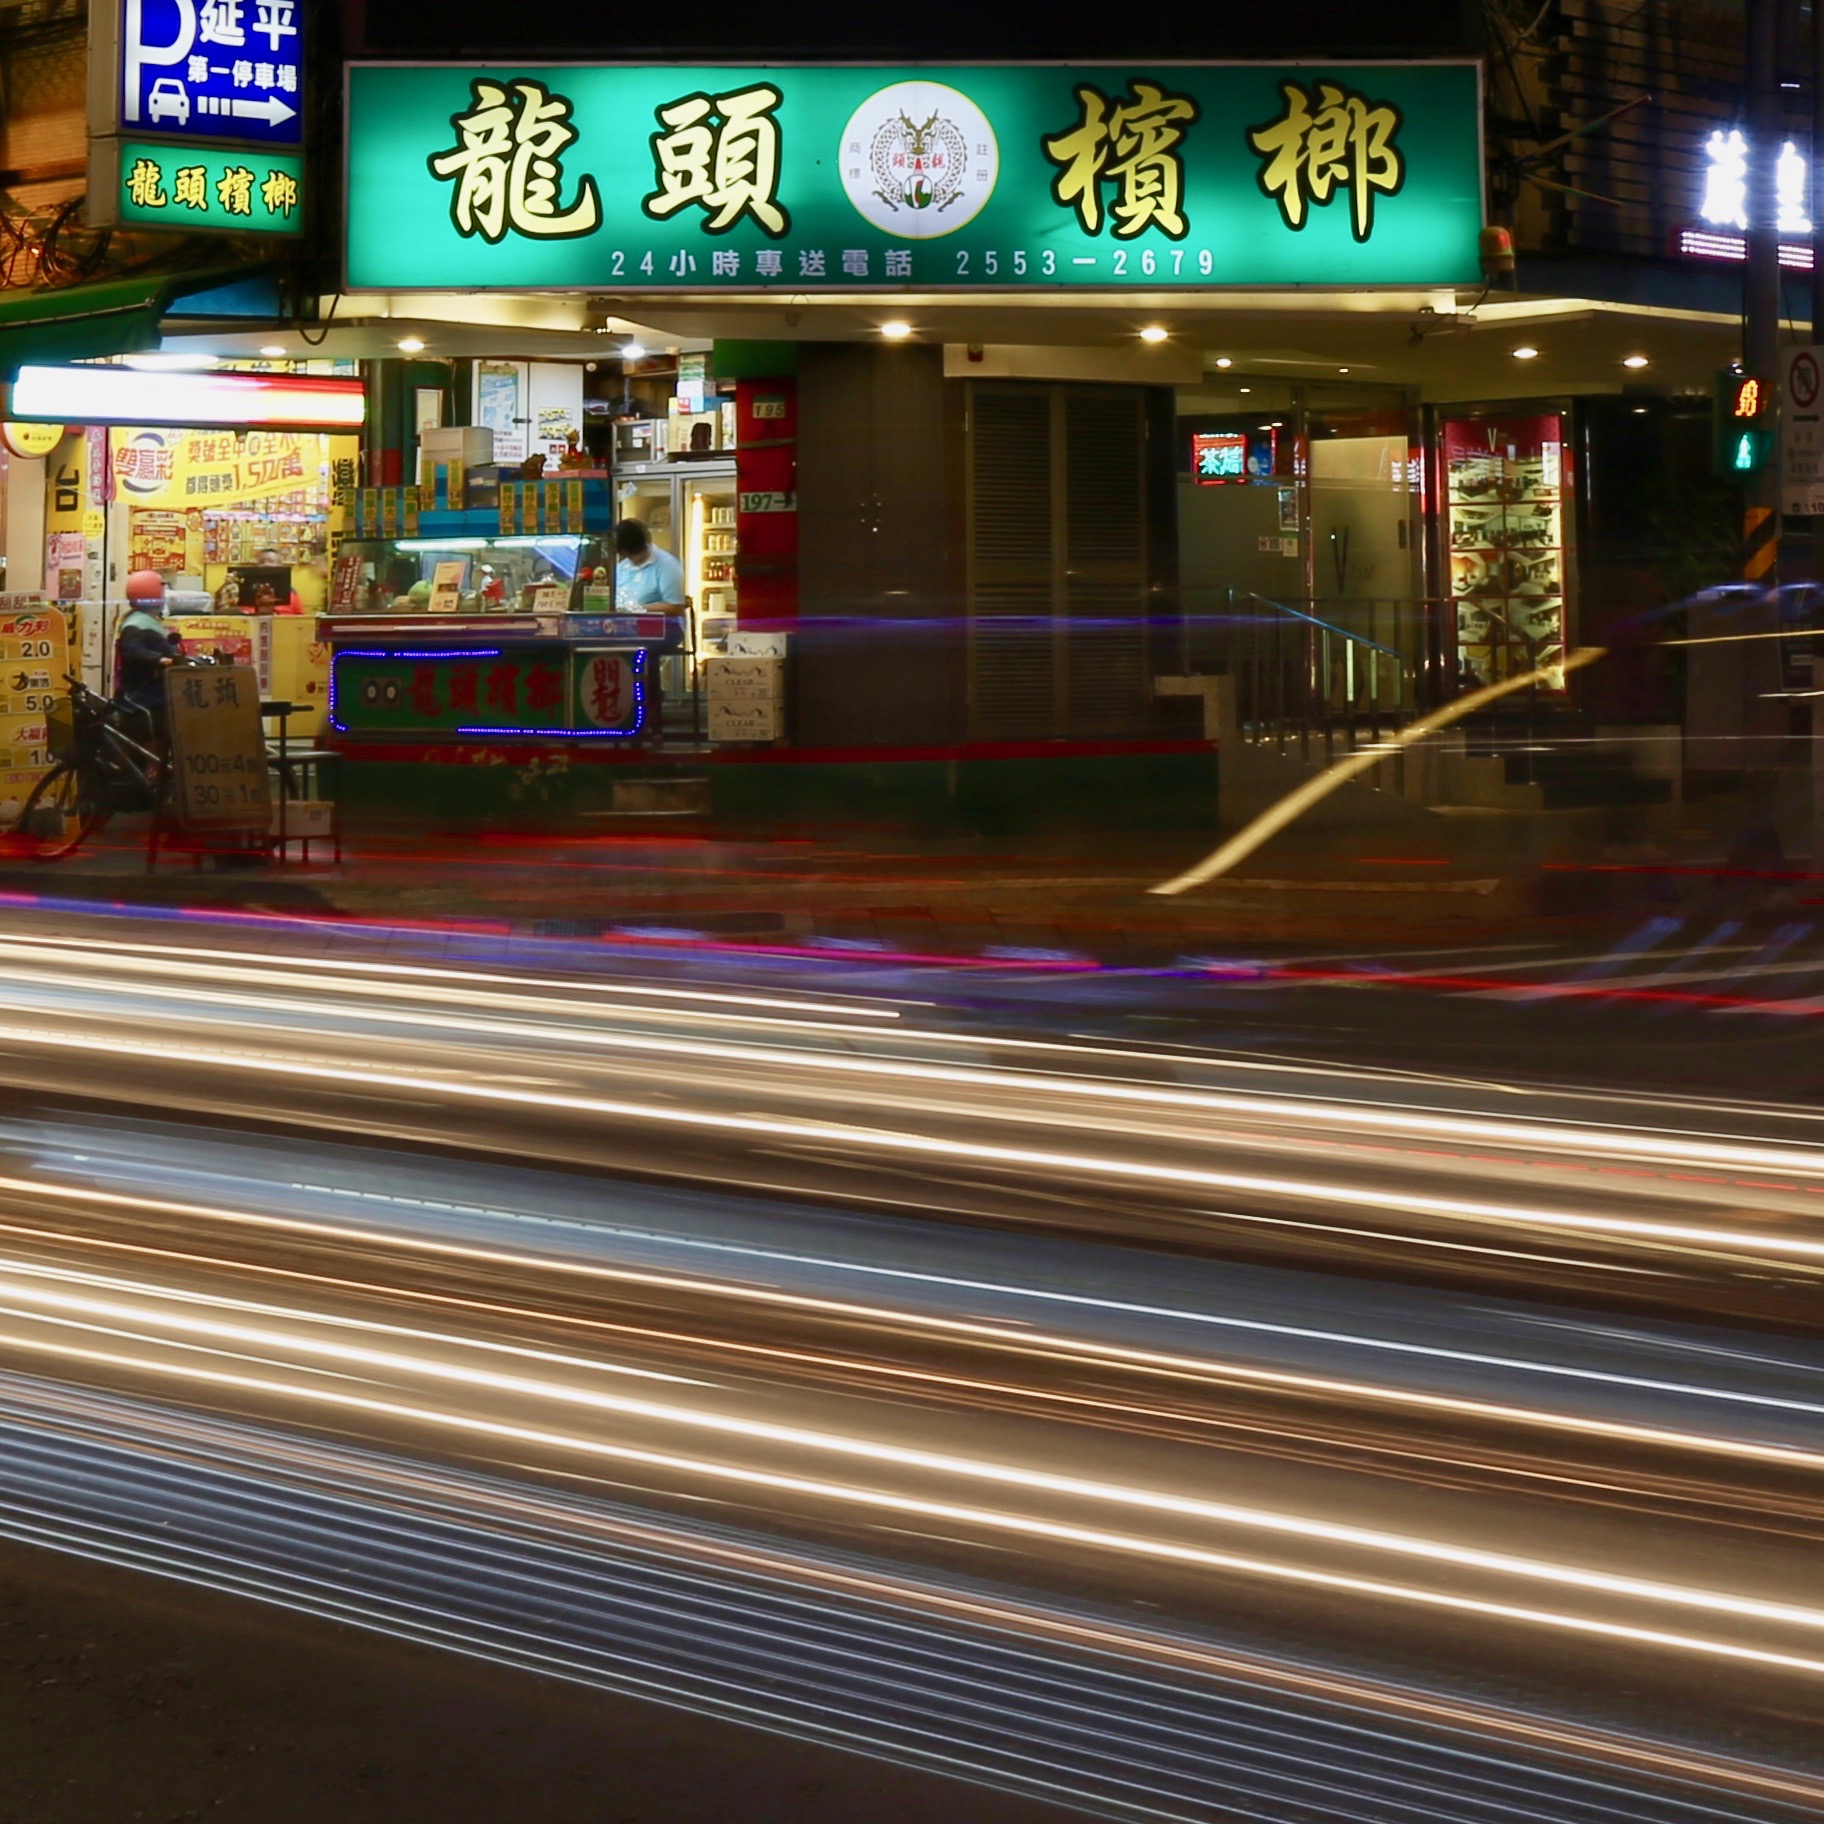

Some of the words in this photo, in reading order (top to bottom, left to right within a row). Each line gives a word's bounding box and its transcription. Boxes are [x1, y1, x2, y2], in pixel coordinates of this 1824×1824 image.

[186, 54, 298, 93] 第一停車場
[431, 81, 789, 240] 龍頭
[1048, 81, 1401, 240] 檳榔
[126, 159, 299, 217] 龍頭檳榔
[611, 248, 915, 278] 24小時專送電話
[754, 403, 785, 419] 195
[741, 494, 773, 512] 197
[21, 641, 51, 658] 2.0
[25, 694, 54, 712] 5.0
[181, 678, 240, 709] 龍頭
